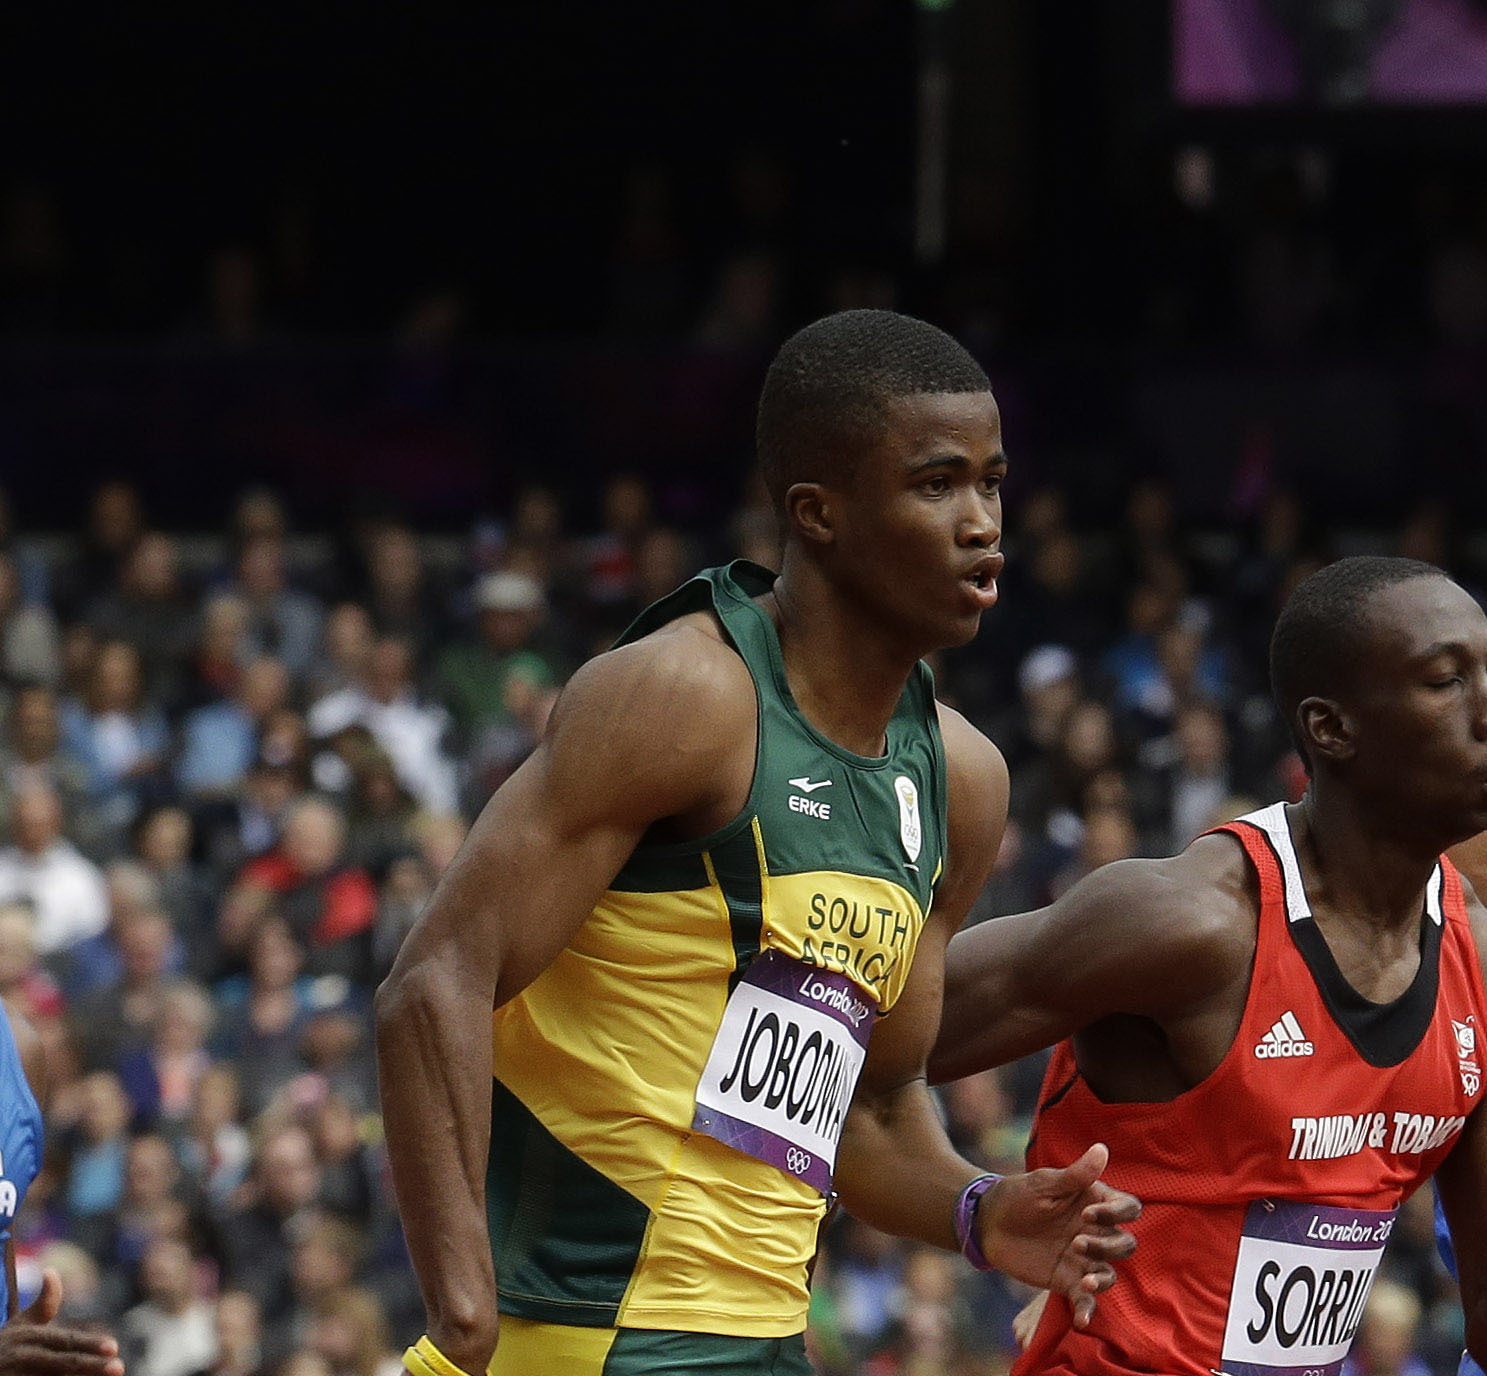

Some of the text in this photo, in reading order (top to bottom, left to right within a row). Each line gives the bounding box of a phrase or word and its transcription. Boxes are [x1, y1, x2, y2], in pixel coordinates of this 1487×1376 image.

[787, 796, 831, 821] ERKE
[807, 892, 910, 950] SOUTH
[1254, 1039, 1314, 1060] adidas
[1368, 1112, 1388, 1148] &
[1306, 1215, 1373, 1242] London
